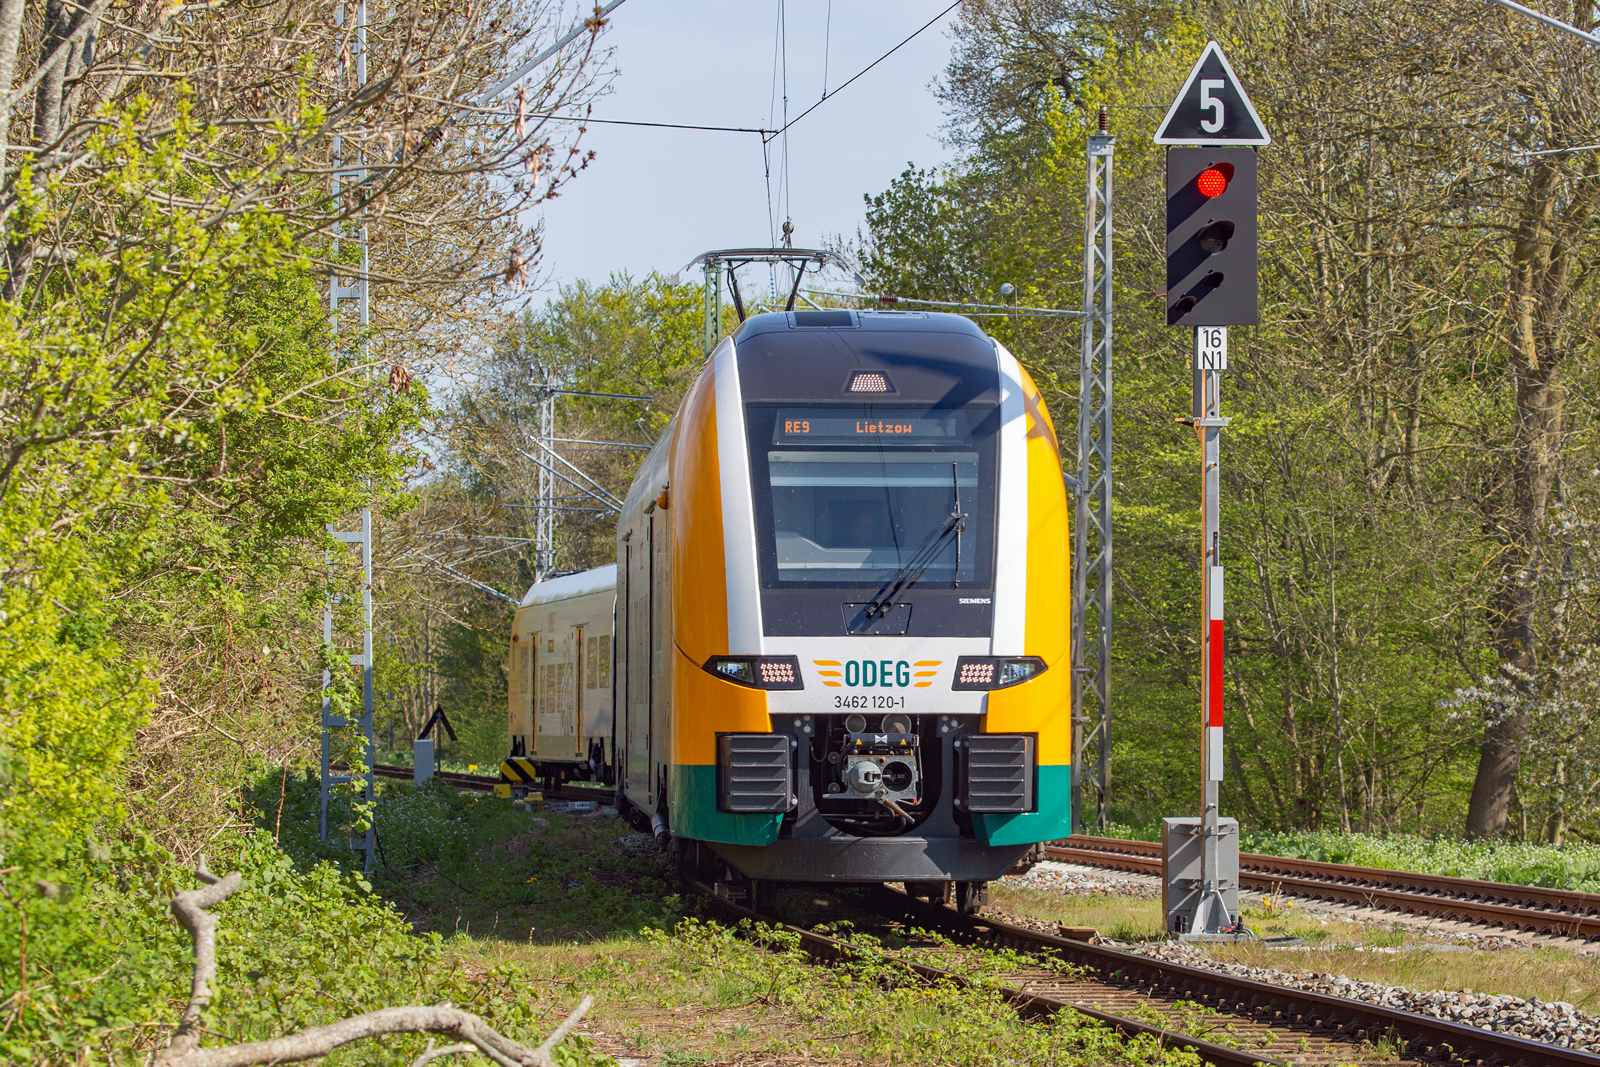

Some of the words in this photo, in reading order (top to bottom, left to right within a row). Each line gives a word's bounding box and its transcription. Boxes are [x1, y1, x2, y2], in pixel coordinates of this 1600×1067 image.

[1200, 79, 1225, 133] 5
[1203, 329, 1222, 349] 16
[1202, 351, 1222, 369] N1
[784, 420, 810, 434] RE9
[855, 420, 912, 434] Lietzow
[958, 597, 992, 605] SIEMENS
[844, 660, 910, 688] ODEG
[834, 695, 868, 709] 3462
[871, 695, 906, 709] 120-1
